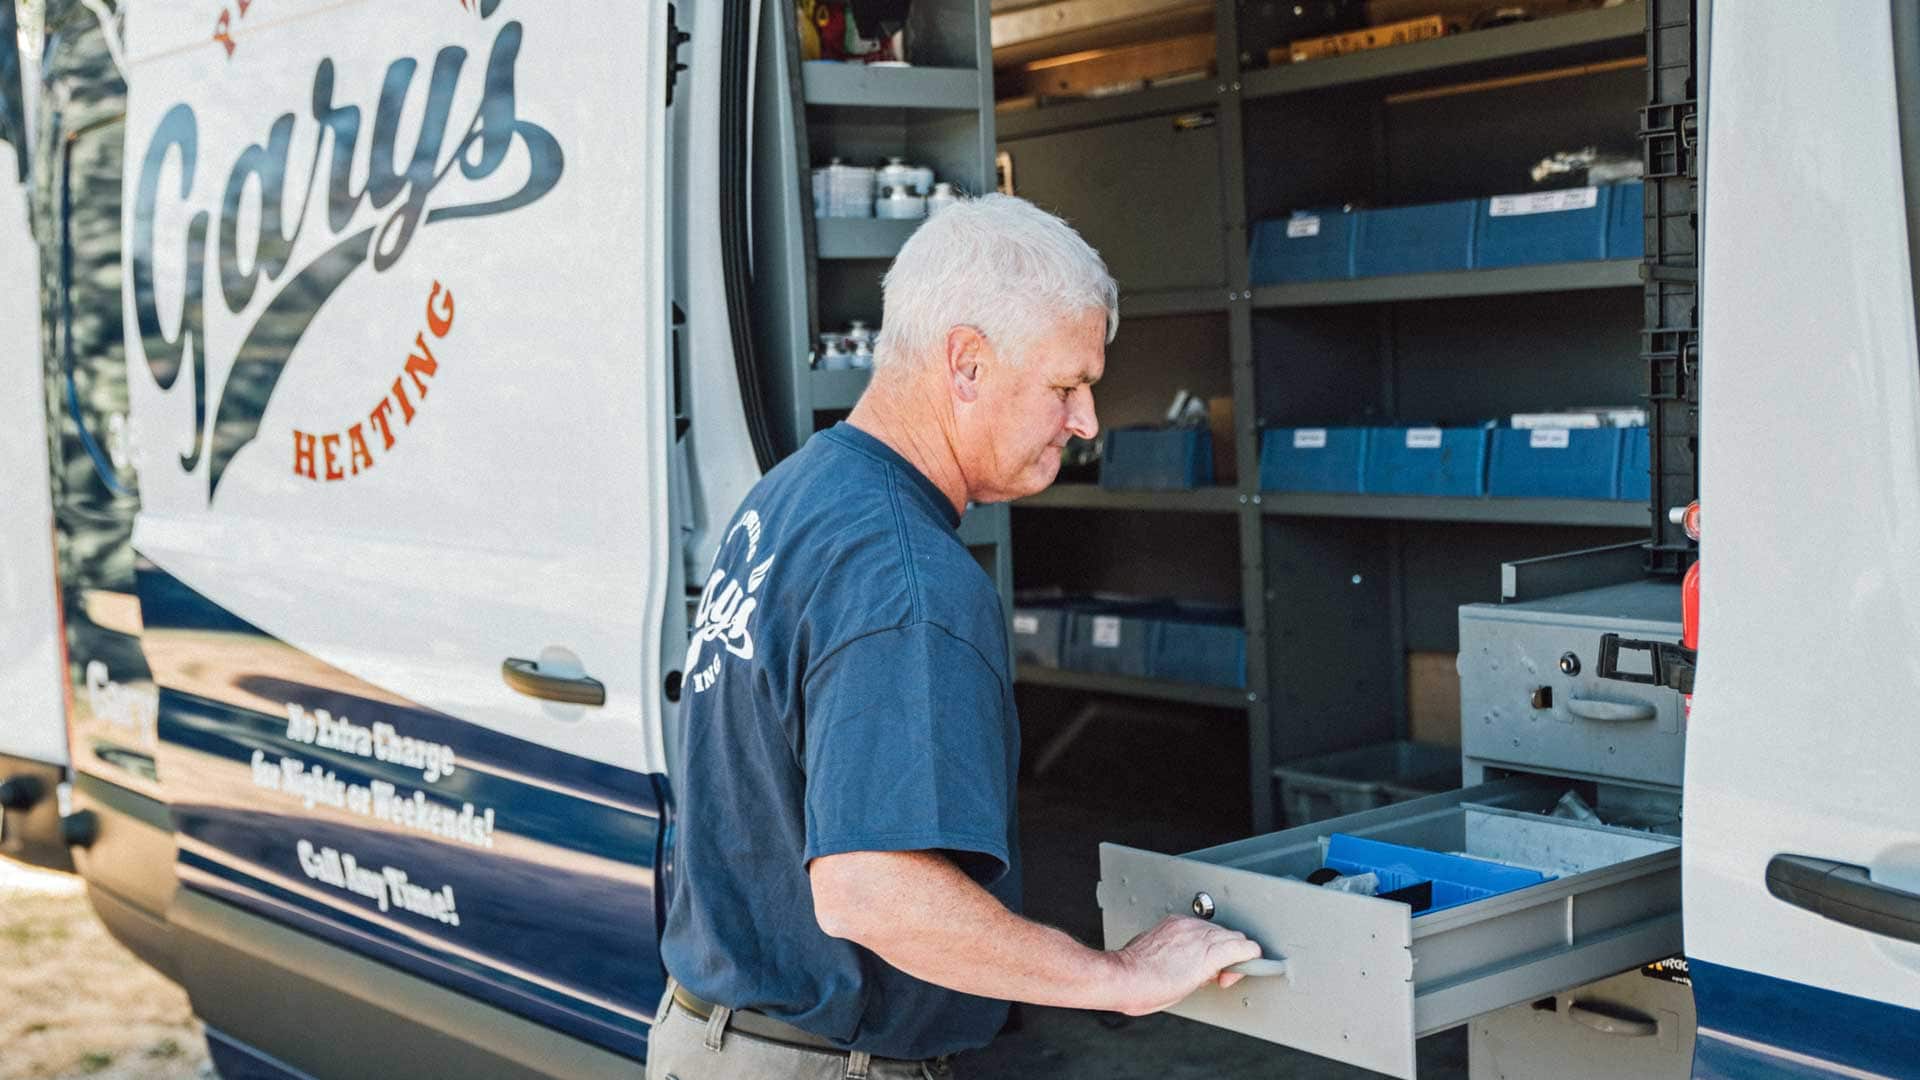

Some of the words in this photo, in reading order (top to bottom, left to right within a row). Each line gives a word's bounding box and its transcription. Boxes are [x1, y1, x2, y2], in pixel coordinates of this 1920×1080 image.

[293, 280, 455, 481] HEATING
[286, 702, 317, 743] No
[315, 708, 373, 757] Extra
[372, 721, 455, 783] Charge
[280, 756, 347, 810] Nights
[347, 783, 371, 815] or
[370, 779, 494, 849] Weekends!
[296, 839, 346, 888] Call
